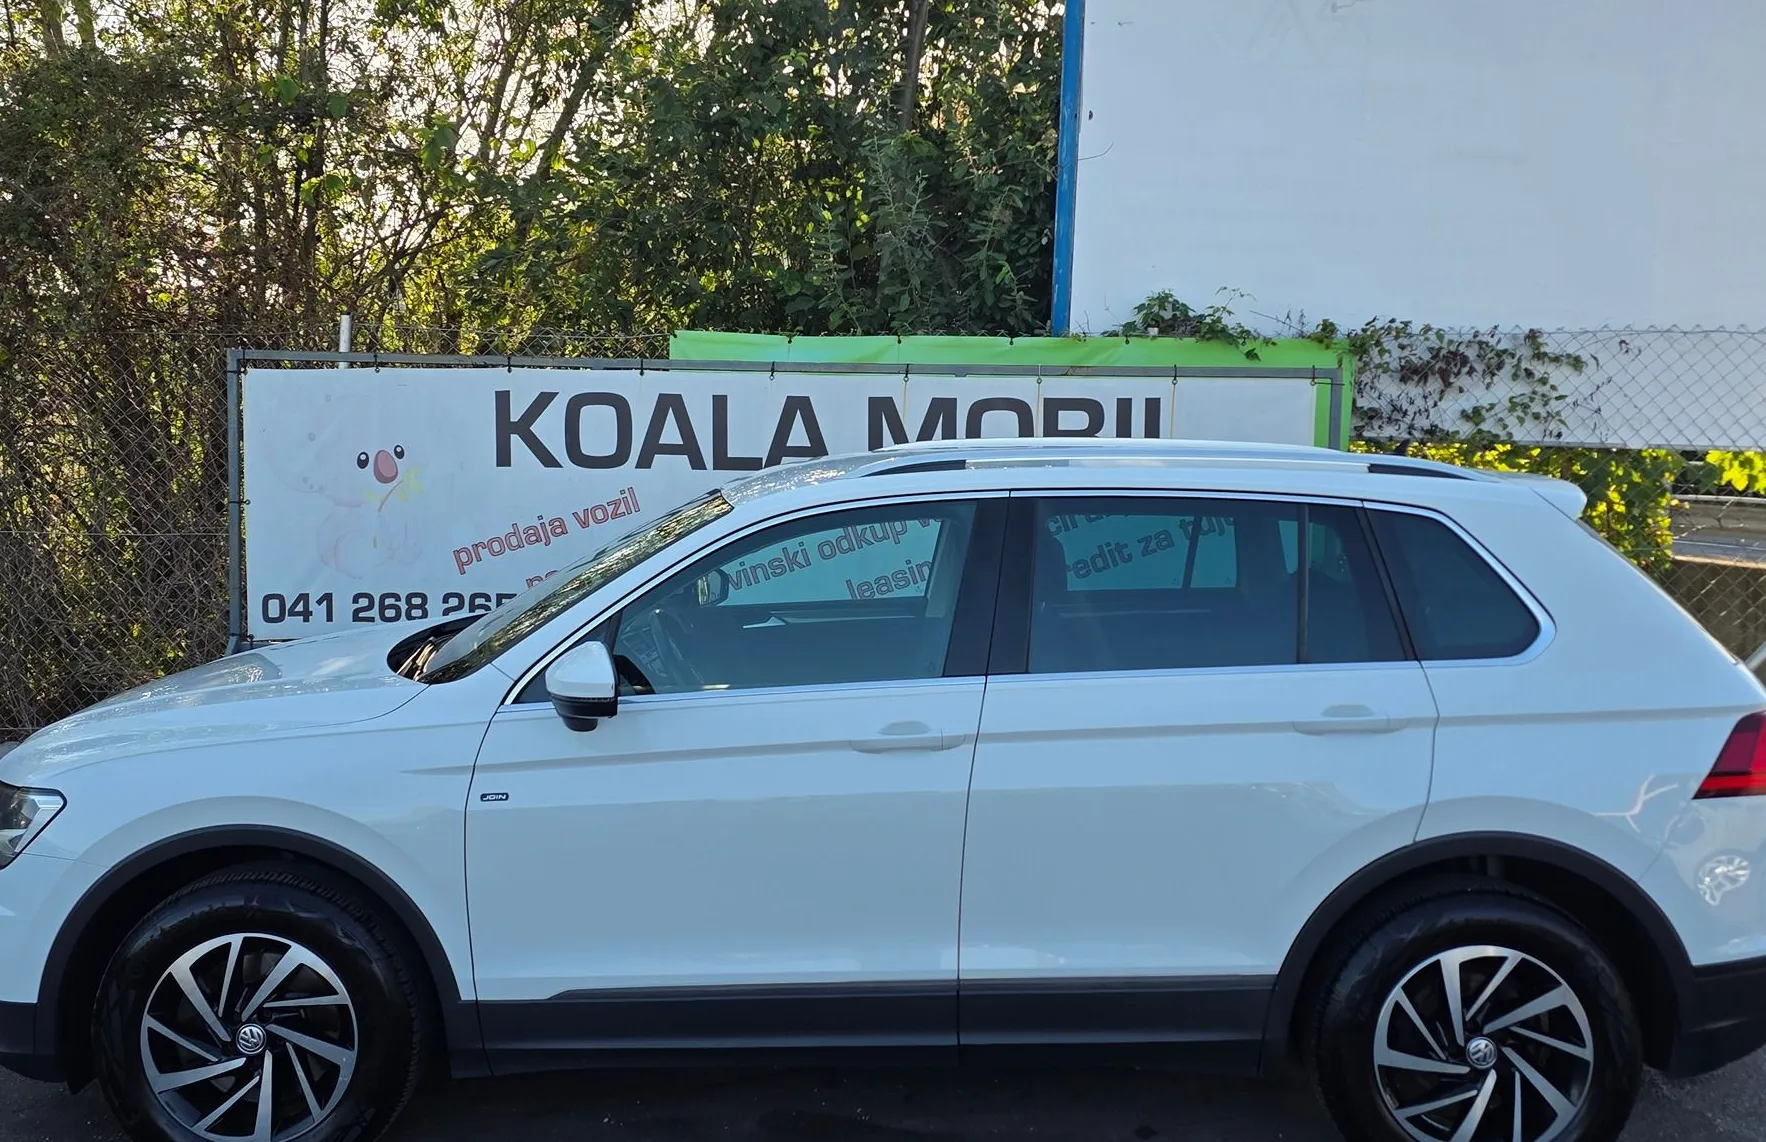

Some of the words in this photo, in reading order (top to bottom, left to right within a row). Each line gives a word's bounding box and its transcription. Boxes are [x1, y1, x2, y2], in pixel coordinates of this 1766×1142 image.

[494, 390, 829, 471] KOALA
[452, 513, 568, 575] prodaja
[572, 486, 642, 530] vozil
[817, 525, 908, 561] odkup
[1067, 542, 1133, 579] edit
[1138, 529, 1175, 557] za
[261, 592, 333, 623] 041
[351, 592, 428, 623] 268
